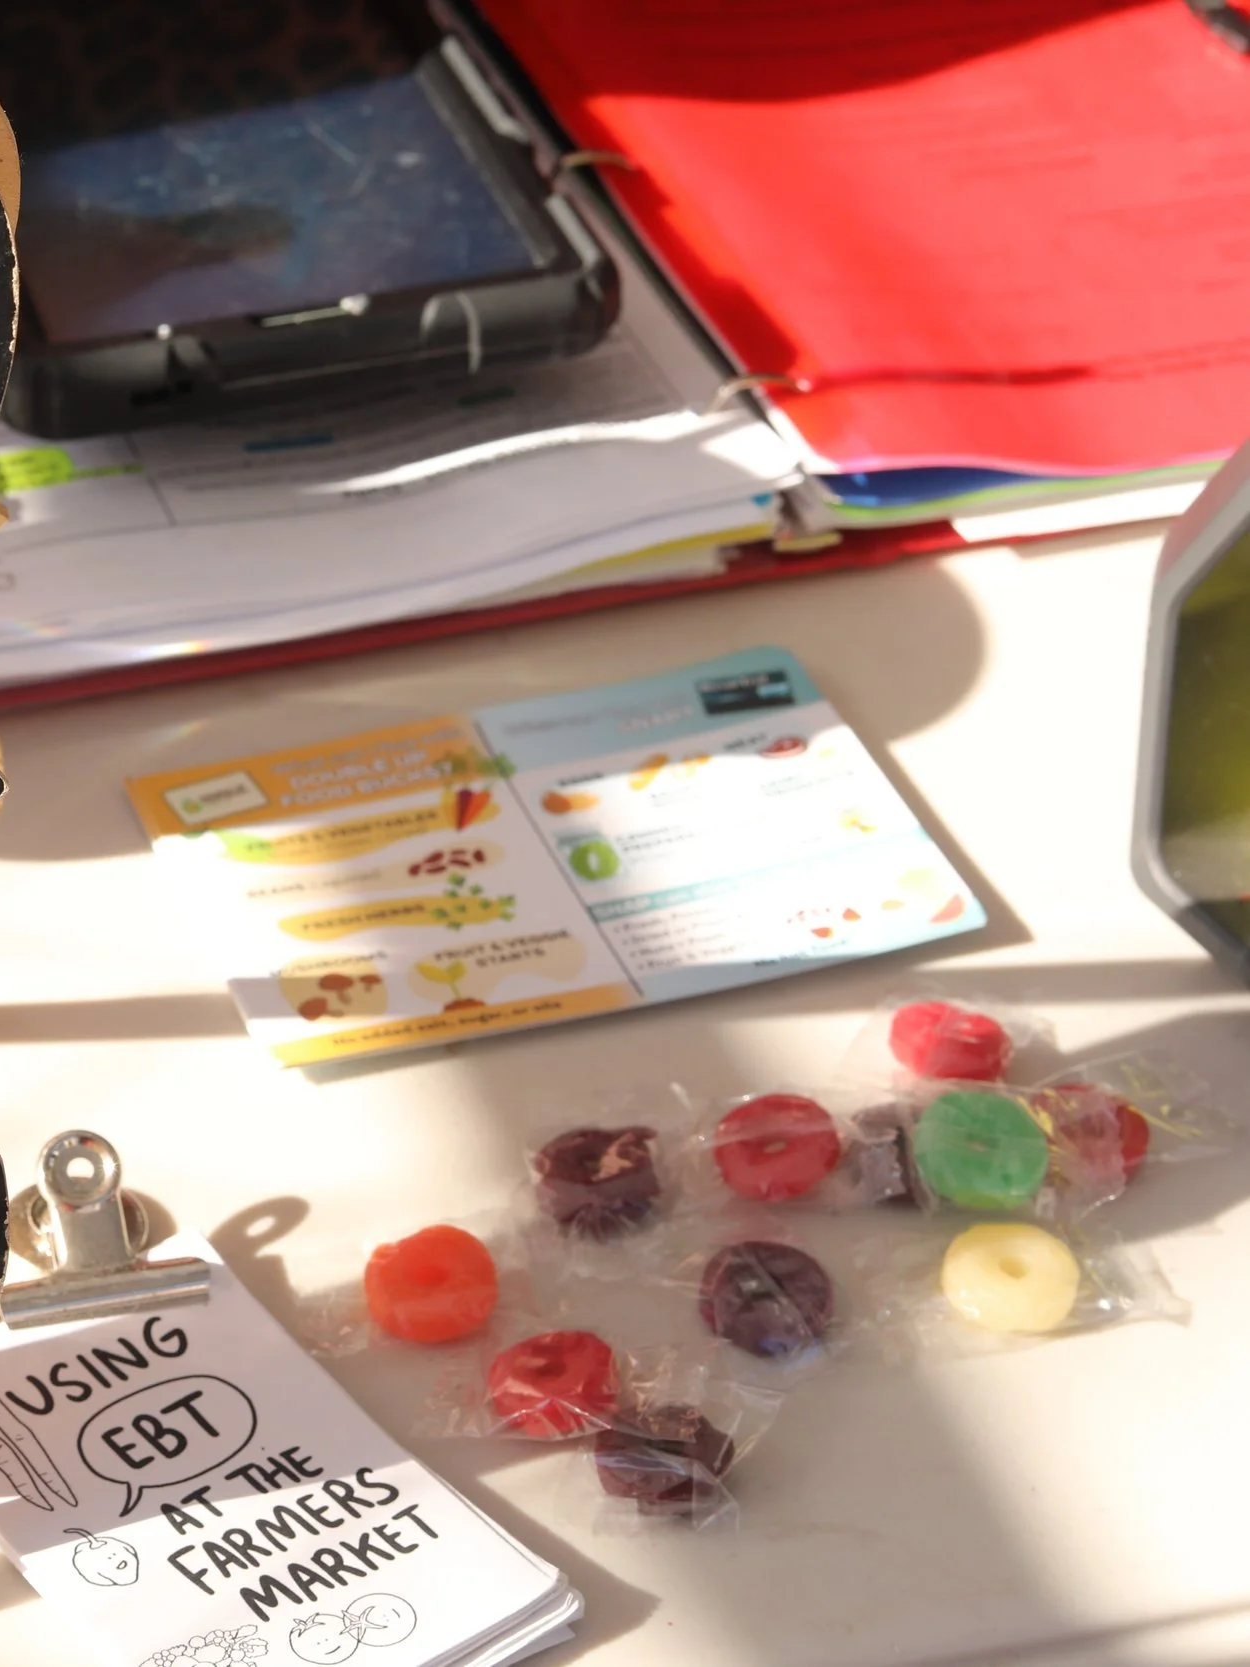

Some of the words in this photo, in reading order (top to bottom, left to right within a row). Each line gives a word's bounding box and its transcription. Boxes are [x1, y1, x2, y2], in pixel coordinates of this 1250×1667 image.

[5, 1316, 189, 1416] USING
[101, 1389, 220, 1471] EBT
[160, 1485, 224, 1536] AT
[225, 1445, 324, 1495] THE
[166, 1467, 401, 1596] FARMERS
[239, 1503, 440, 1623] MARKET
